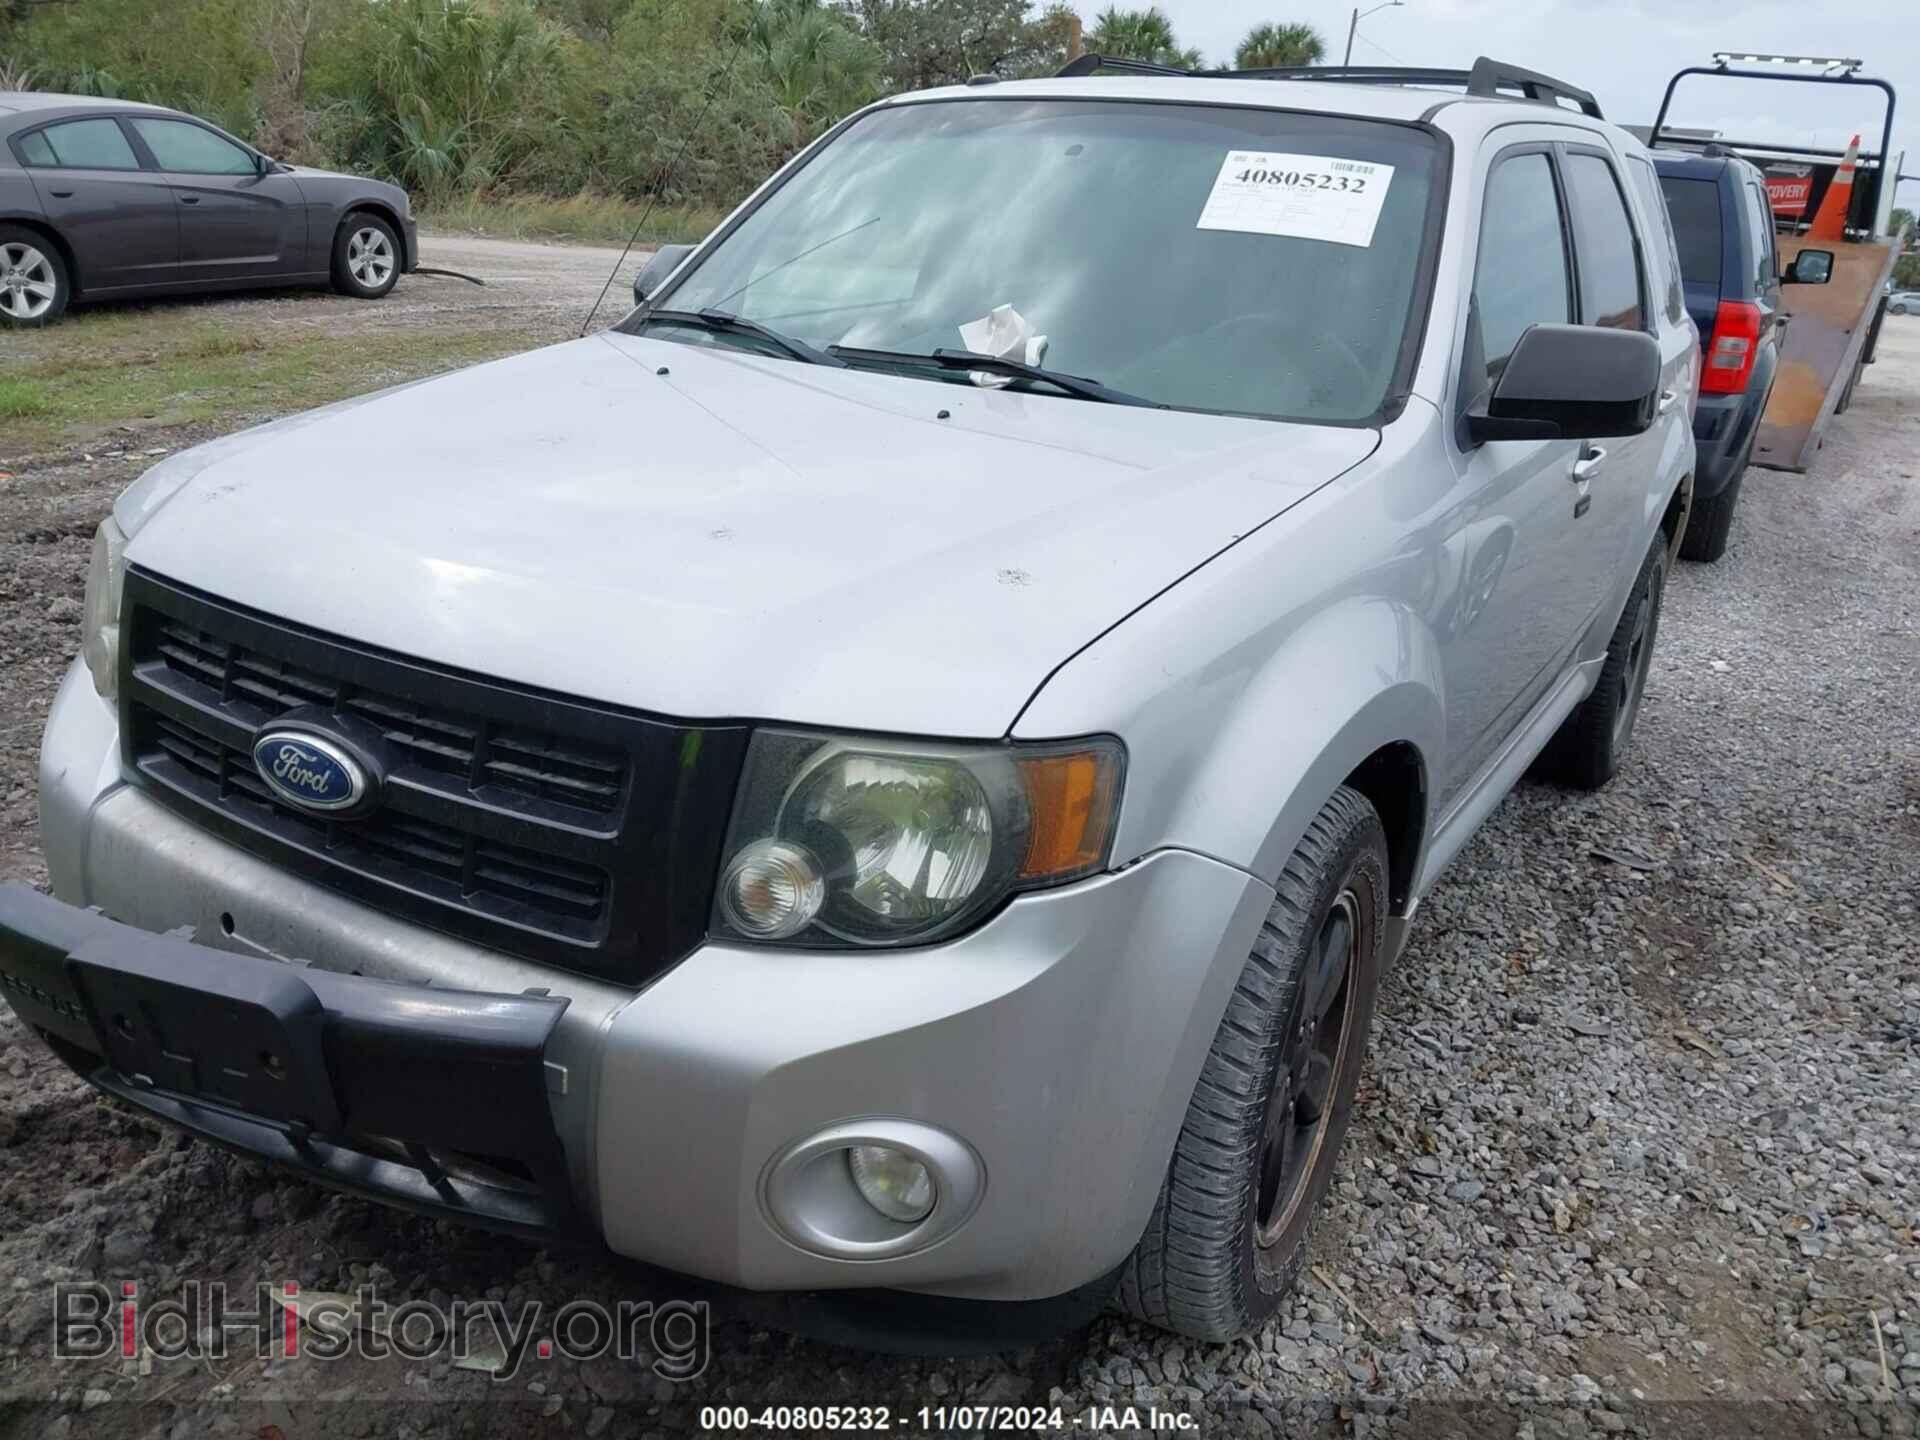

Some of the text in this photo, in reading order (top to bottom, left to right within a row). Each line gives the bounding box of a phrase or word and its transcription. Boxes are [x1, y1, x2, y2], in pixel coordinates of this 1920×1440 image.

[1235, 168, 1366, 194] 40805232
[1767, 184, 1807, 199] COVERY
[273, 745, 331, 793] Ford
